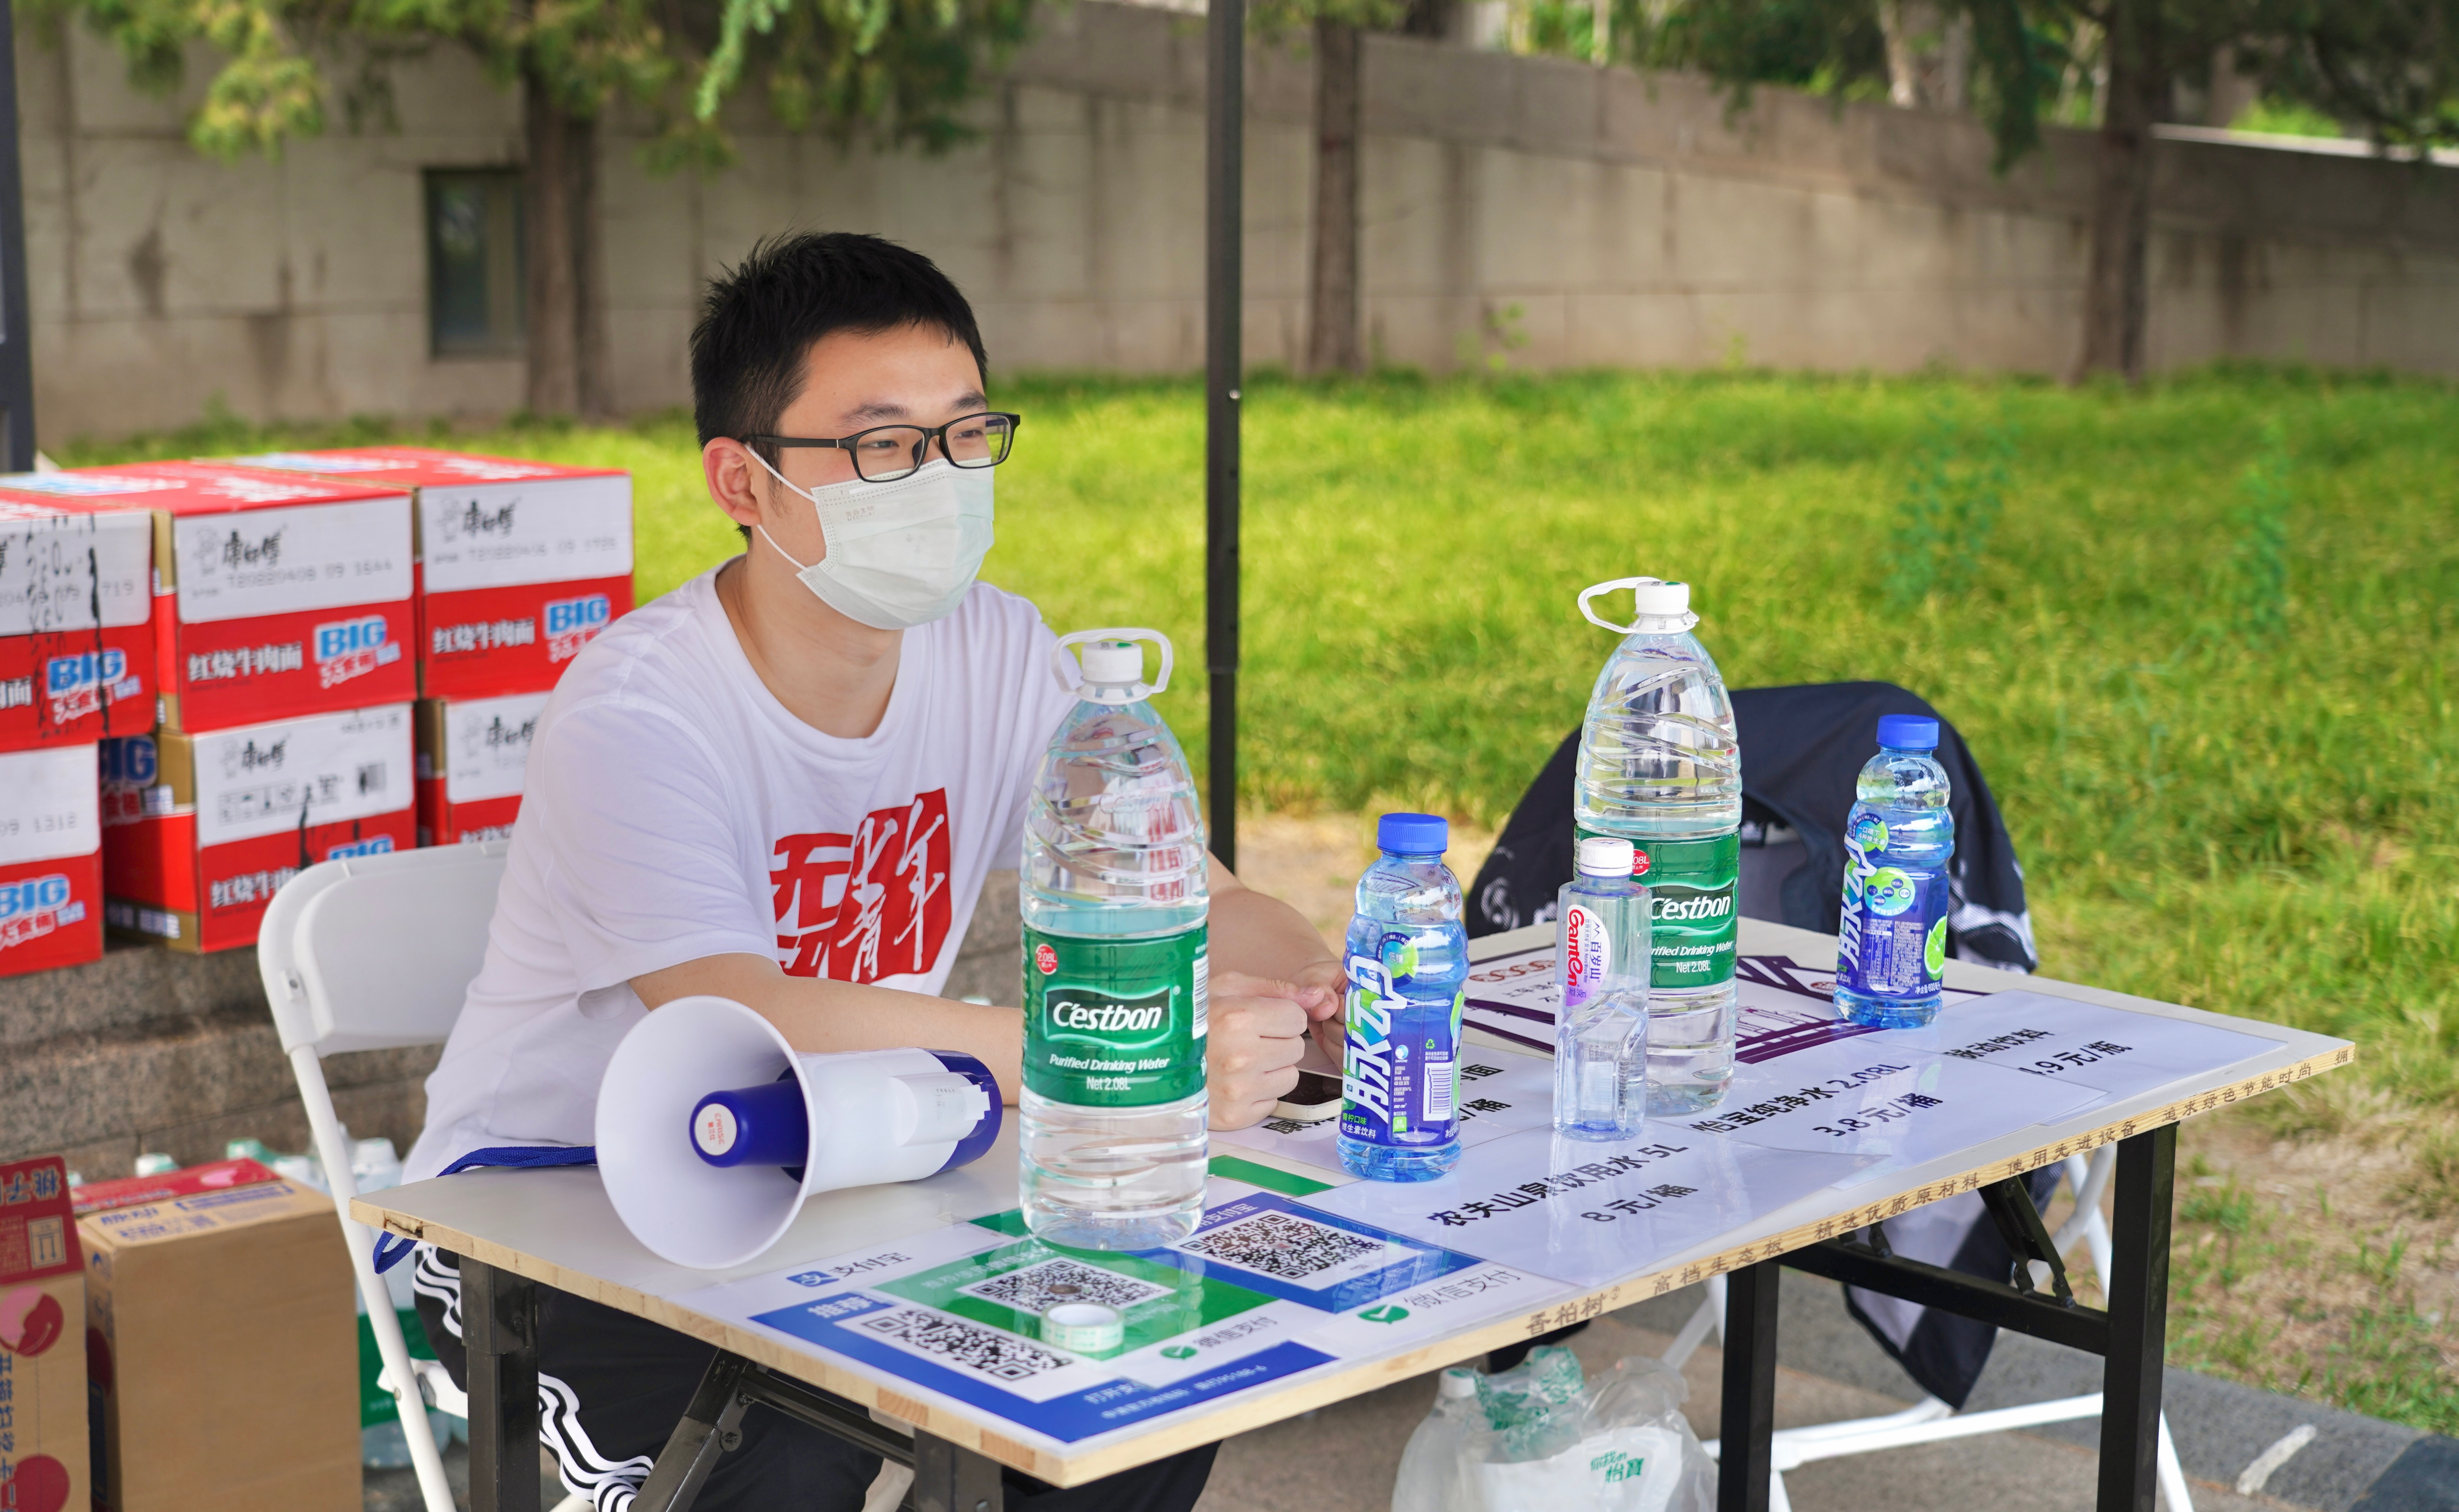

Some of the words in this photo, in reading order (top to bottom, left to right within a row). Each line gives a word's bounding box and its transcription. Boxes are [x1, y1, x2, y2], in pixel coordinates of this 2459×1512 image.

[549, 598, 609, 635] BIG
[319, 620, 386, 659] BIG
[433, 617, 536, 655] 红烧牛肉面
[48, 651, 124, 694] BIG
[188, 641, 303, 683] 红烧牛肉面
[1633, 856, 1650, 865] 08L
[1037, 951, 1057, 963] 2.08L
[1388, 951, 1404, 964] 低糖
[1567, 909, 1584, 987] Ganten
[1590, 942, 1601, 979] 百岁山
[1680, 945, 1715, 956] Drinking
[1716, 941, 1733, 951] Water
[1676, 962, 1690, 973] Net
[1691, 960, 1711, 972] 2.08L
[1053, 1001, 1162, 1032] C'estbon
[1049, 1053, 1088, 1070] Purified
[1089, 1059, 1136, 1074] Drinking
[1138, 1056, 1170, 1070] Water
[2052, 1040, 2133, 1066] 元/瓶
[1086, 1076, 1103, 1090] Net
[1104, 1077, 1131, 1091] 2.08L
[1689, 1087, 1840, 1133] 怡宝纯净水
[1826, 1063, 1912, 1089] 2.08L
[715, 1113, 725, 1145] EARISE
[1342, 1122, 1376, 1139] 维生素饮料
[1343, 1113, 1367, 1125] 青柠口味
[1812, 1118, 1871, 1137] 3.8
[1857, 1092, 1943, 1123] 元/桶
[1427, 1156, 1650, 1226] 农夫山泉饮用水
[1637, 1144, 1690, 1158] 5L
[1652, 1237, 1785, 1295] 高档生态板
[1814, 1172, 1980, 1240] 精选优质原材料
[2007, 1120, 2137, 1176] 使用先进设备
[2161, 1062, 2312, 1123] 追求绿色节能时尚
[1580, 1211, 1616, 1222] 8
[1603, 1183, 1699, 1214] 元/桶
[827, 1252, 914, 1277] 支付宝
[1403, 1269, 1521, 1309] 微信支付
[1193, 1315, 1278, 1347] 微信支付
